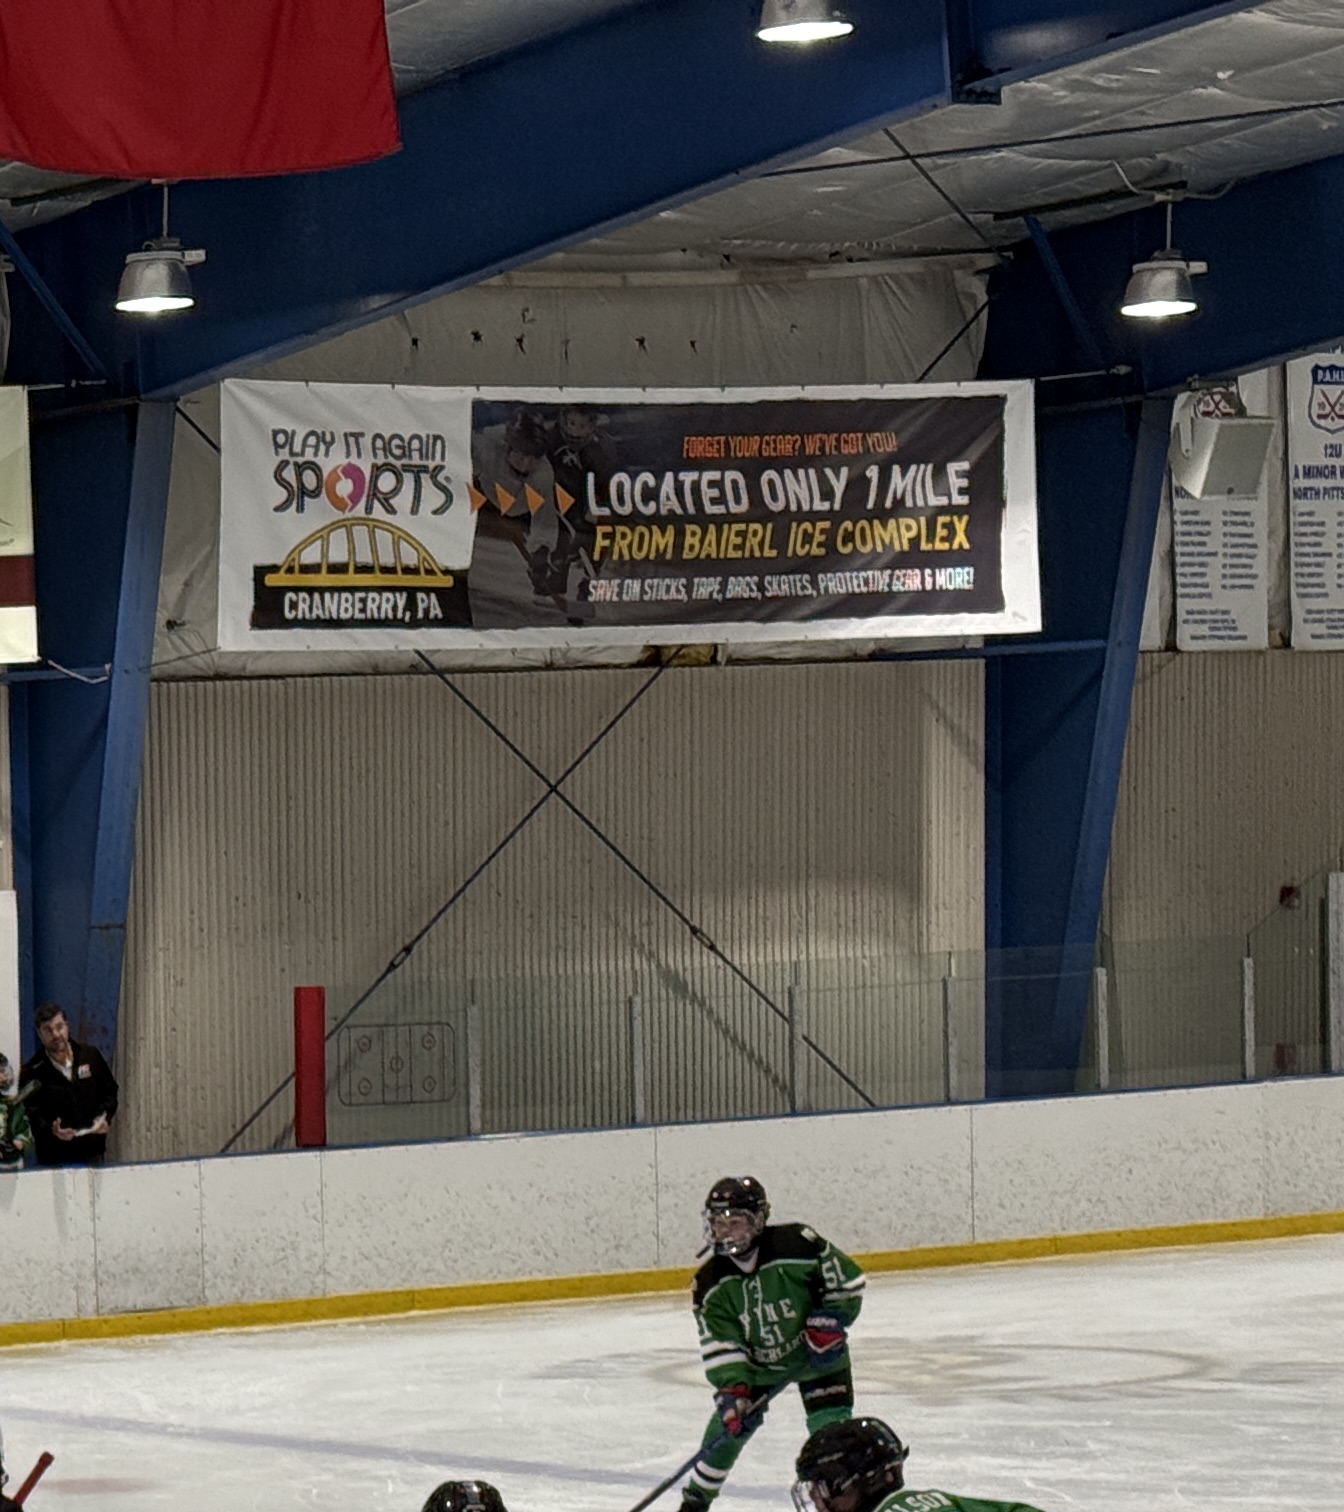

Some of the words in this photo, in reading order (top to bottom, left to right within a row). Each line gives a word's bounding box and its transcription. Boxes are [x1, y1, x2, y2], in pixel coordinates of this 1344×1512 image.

[272, 428, 335, 458] PLAY
[343, 431, 366, 459] IT
[372, 433, 447, 462] AGAIN
[682, 435, 726, 459] FORGET
[729, 435, 760, 458] YOUR
[762, 434, 801, 457] GEAR?
[841, 432, 864, 454] GOT
[272, 460, 454, 516] SPORTS
[587, 470, 750, 517] LOCATED
[760, 467, 849, 514] ONLY
[865, 464, 881, 510] 1
[884, 460, 970, 510] MILE
[592, 524, 676, 562] FROM
[682, 521, 778, 560] BAIERL
[786, 520, 832, 558] ICE
[836, 514, 972, 555] COMPLEX
[588, 579, 621, 602] SAVE
[622, 579, 642, 602] ON
[764, 572, 817, 599] SKATES,
[817, 569, 891, 597] PROTECTIVE
[892, 568, 921, 593] GEAR
[936, 566, 975, 592] MORE!
[284, 591, 411, 623] CRANBERRY,
[416, 592, 444, 620] PA
[821, 1256, 847, 1291] 51
